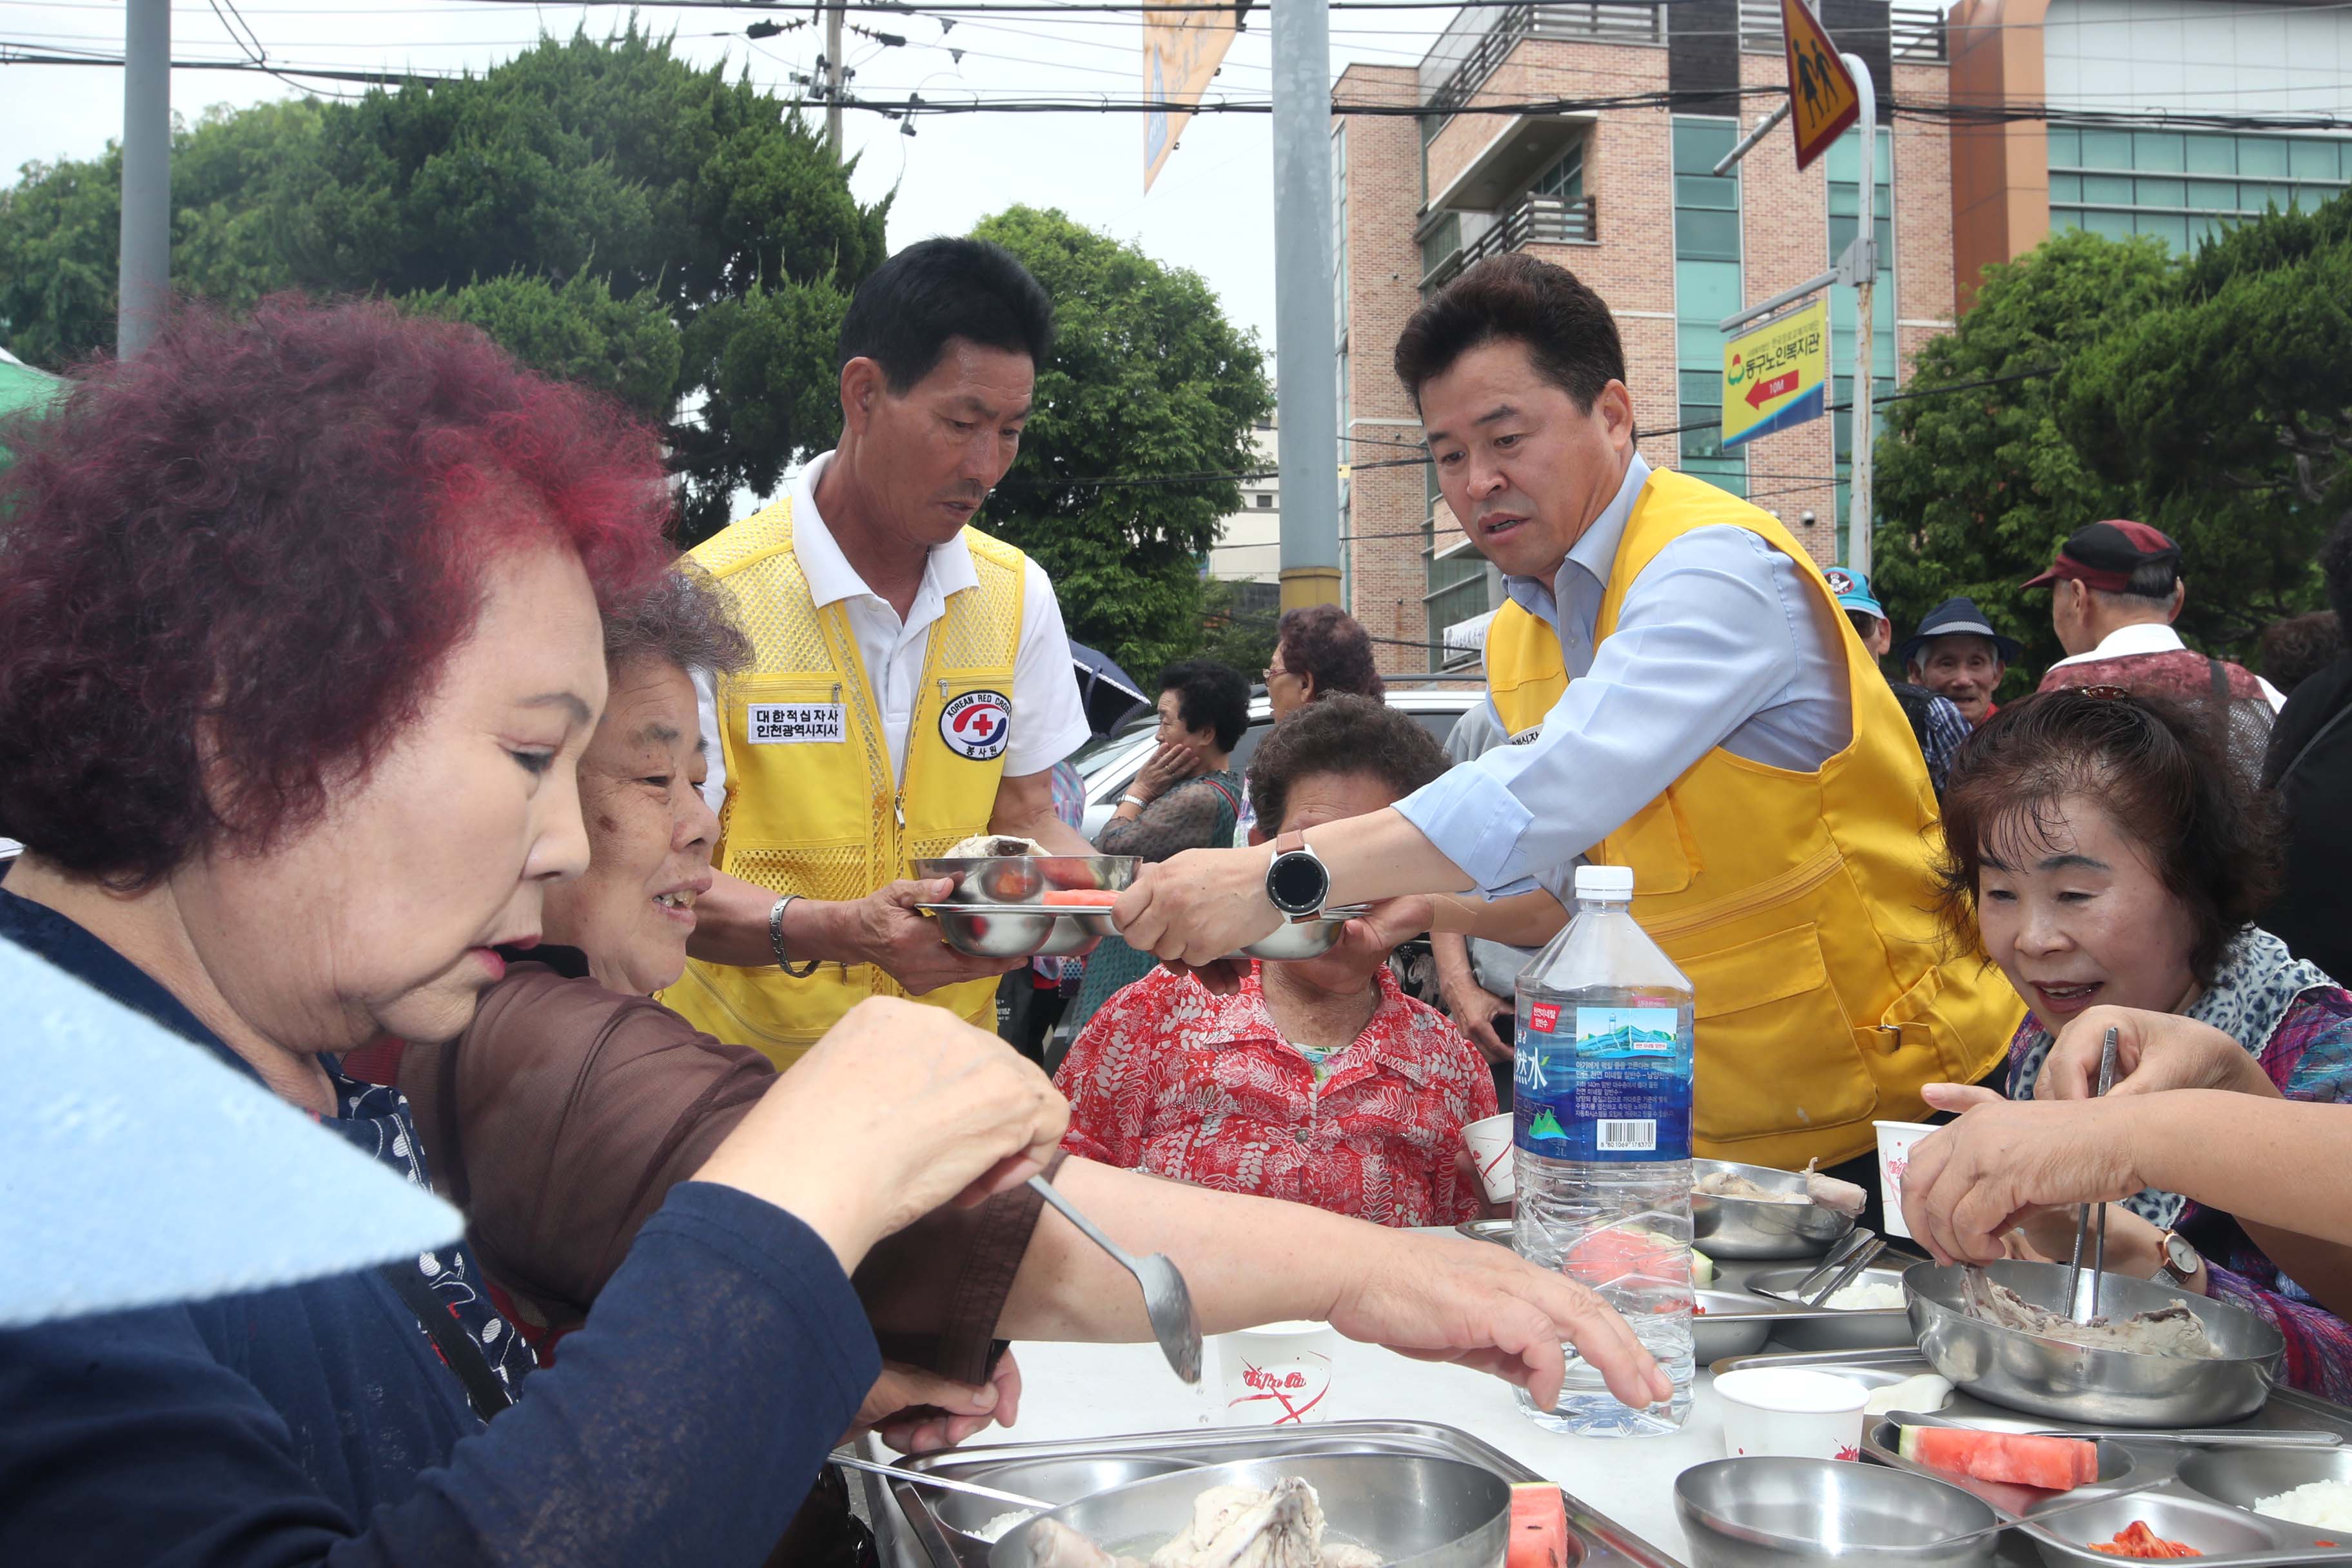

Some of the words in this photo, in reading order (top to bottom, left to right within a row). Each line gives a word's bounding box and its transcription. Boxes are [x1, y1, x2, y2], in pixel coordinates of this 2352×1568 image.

[1746, 332, 1820, 379] 동구노인복지관
[946, 696, 974, 718] KOREAN
[977, 694, 992, 703] RED
[995, 698, 1011, 717] CROSS
[756, 724, 839, 738] 인천광역시지사
[966, 745, 998, 758] 봉사원
